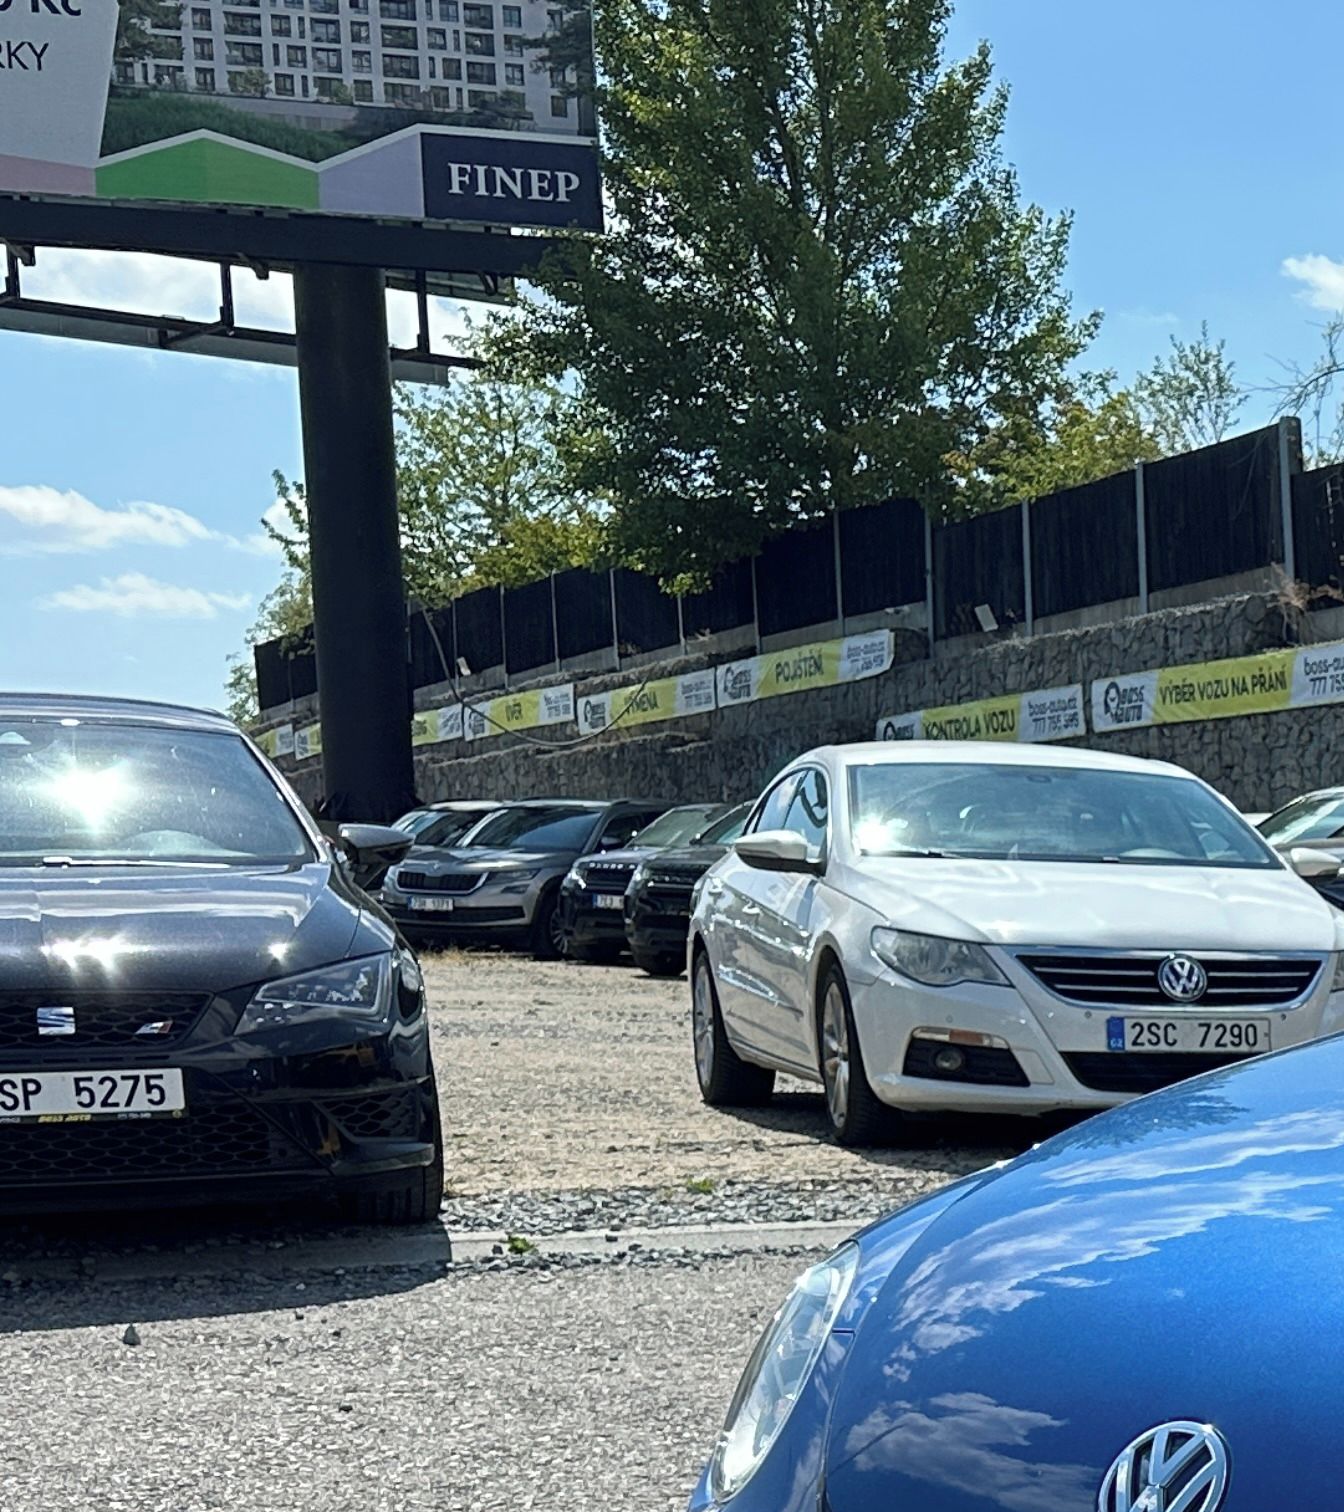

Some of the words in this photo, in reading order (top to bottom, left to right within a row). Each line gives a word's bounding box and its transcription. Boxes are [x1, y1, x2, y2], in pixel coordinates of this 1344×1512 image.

[0, 40, 49, 71] KY
[447, 162, 580, 203] FINEP
[1198, 678, 1229, 701] VOZU
[1230, 676, 1248, 698] NA
[1309, 676, 1327, 696] 777
[924, 715, 981, 741] KONTROLA
[984, 708, 1016, 734] VOZU
[1130, 1021, 1178, 1047] 2SC
[1198, 1023, 1258, 1048] 7290
[73, 1073, 166, 1109] 5275
